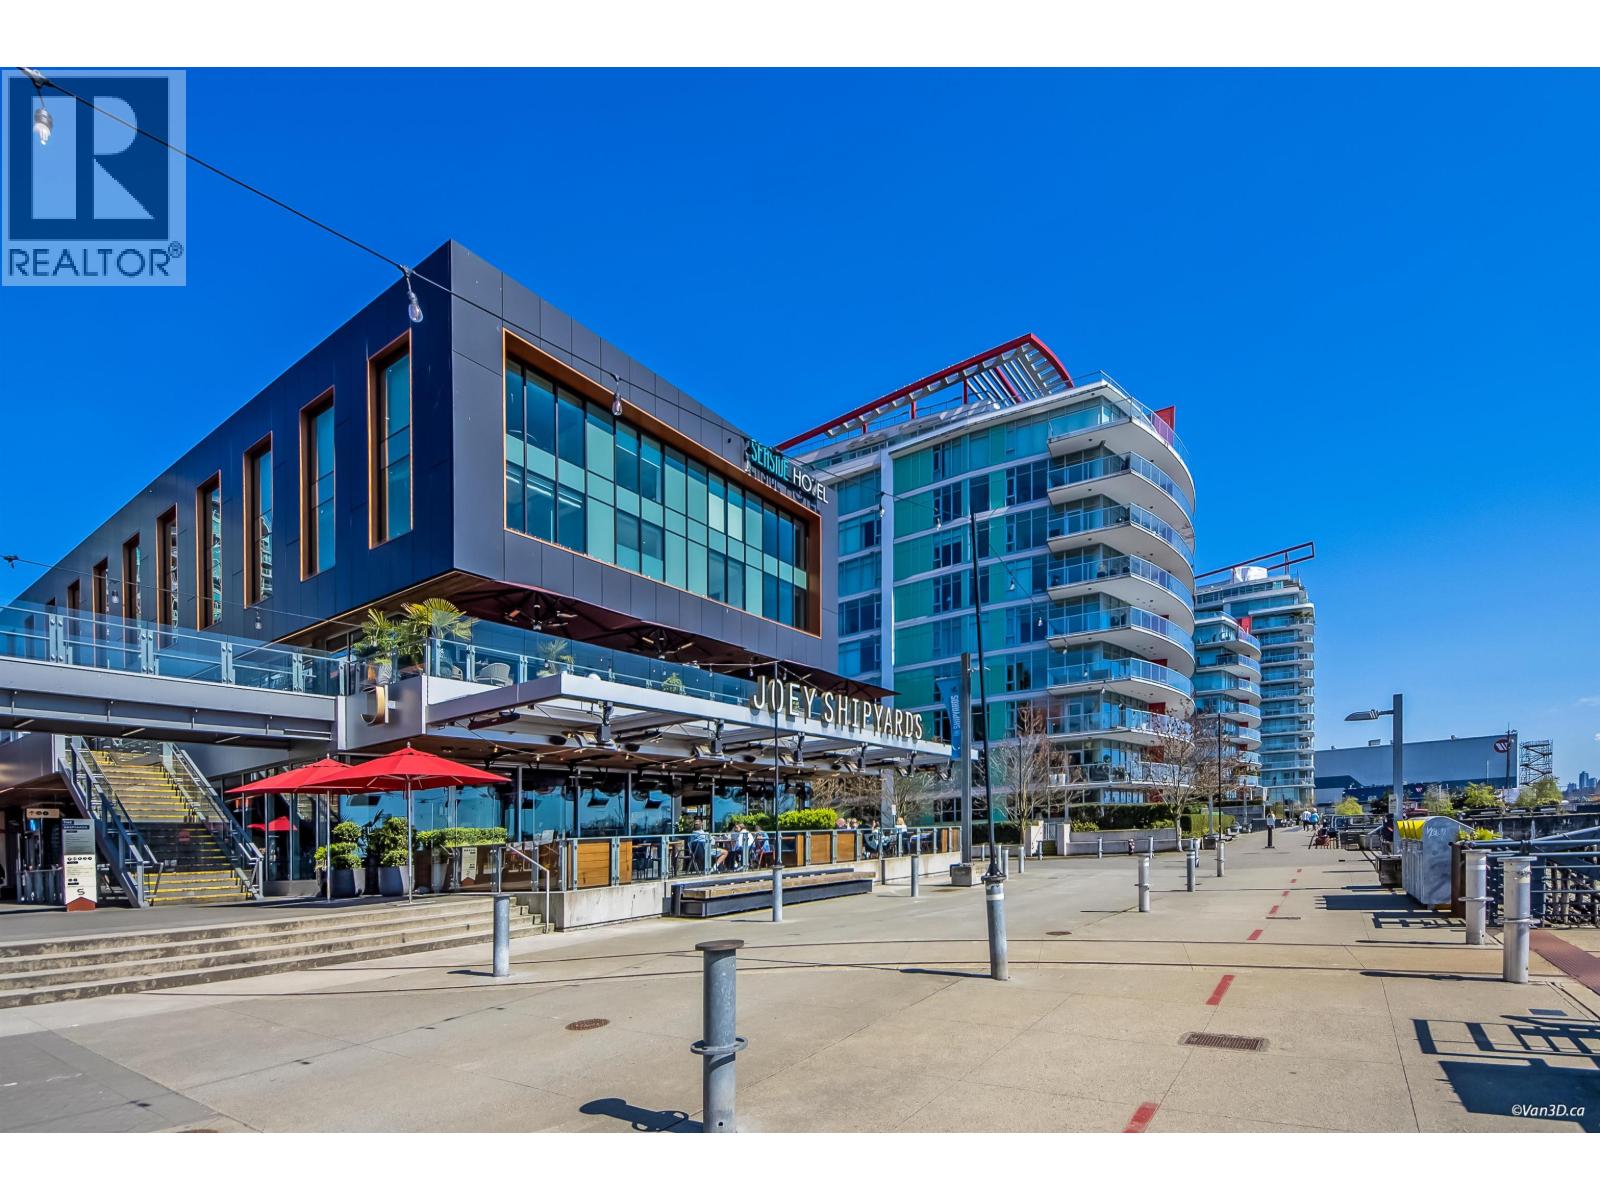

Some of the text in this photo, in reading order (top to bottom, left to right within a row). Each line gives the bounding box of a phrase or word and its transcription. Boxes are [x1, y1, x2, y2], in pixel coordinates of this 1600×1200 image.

[751, 440, 829, 504] SEASIDE HOEL
[753, 675, 923, 740] JOEY SHIPYARDS
